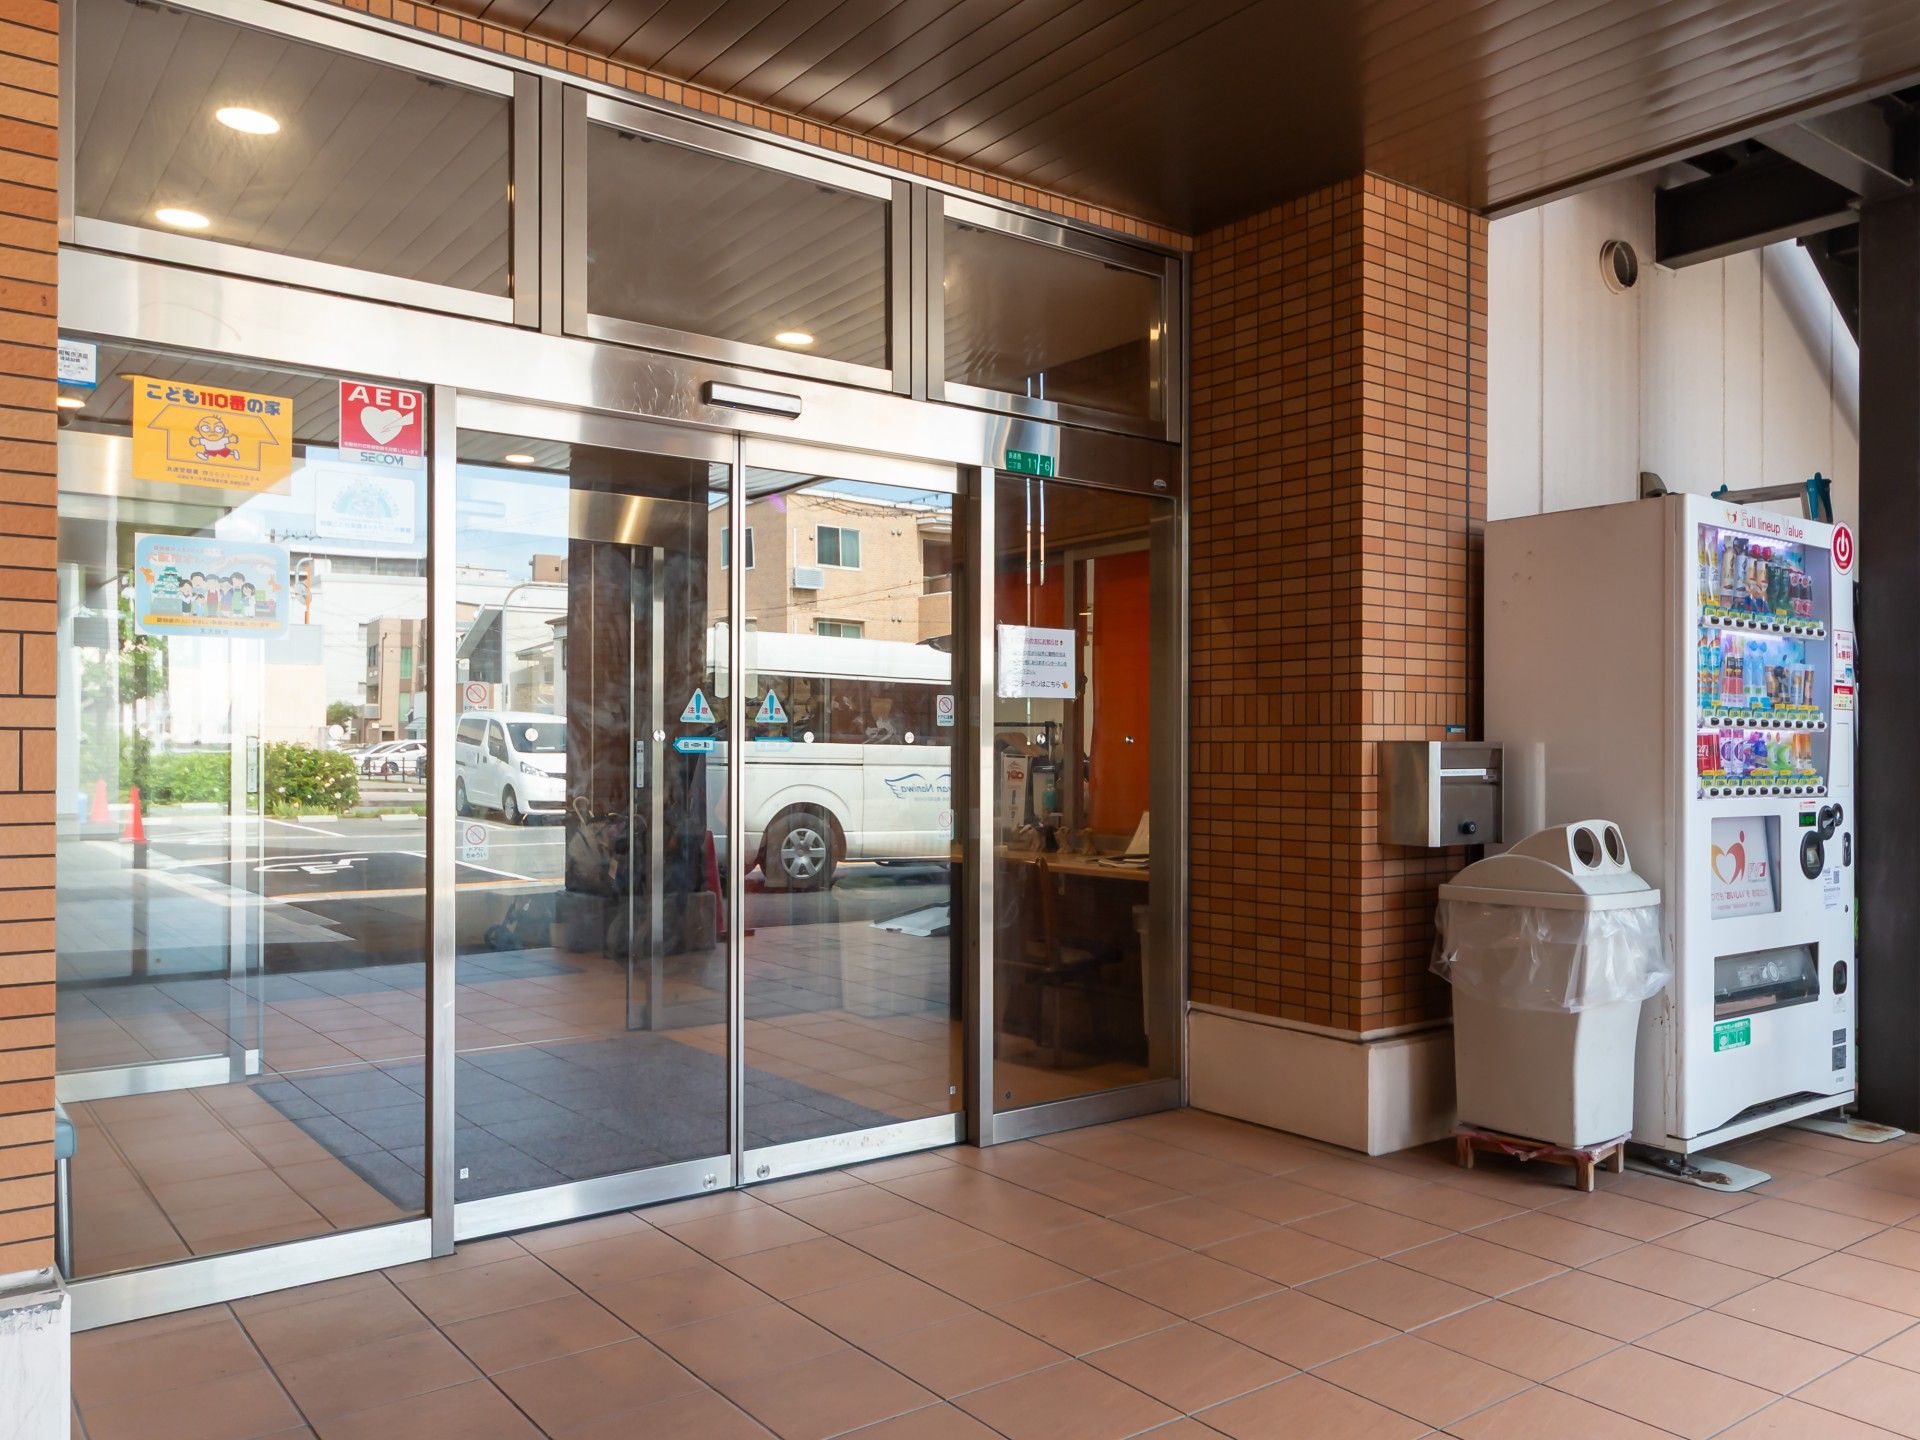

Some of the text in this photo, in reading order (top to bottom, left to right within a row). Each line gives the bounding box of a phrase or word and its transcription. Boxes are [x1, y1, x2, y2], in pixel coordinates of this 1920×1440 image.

[146, 383, 281, 416] こども110番の家
[347, 385, 416, 410] AED
[360, 451, 404, 466] SECOM
[1757, 516, 1780, 536] lineup
